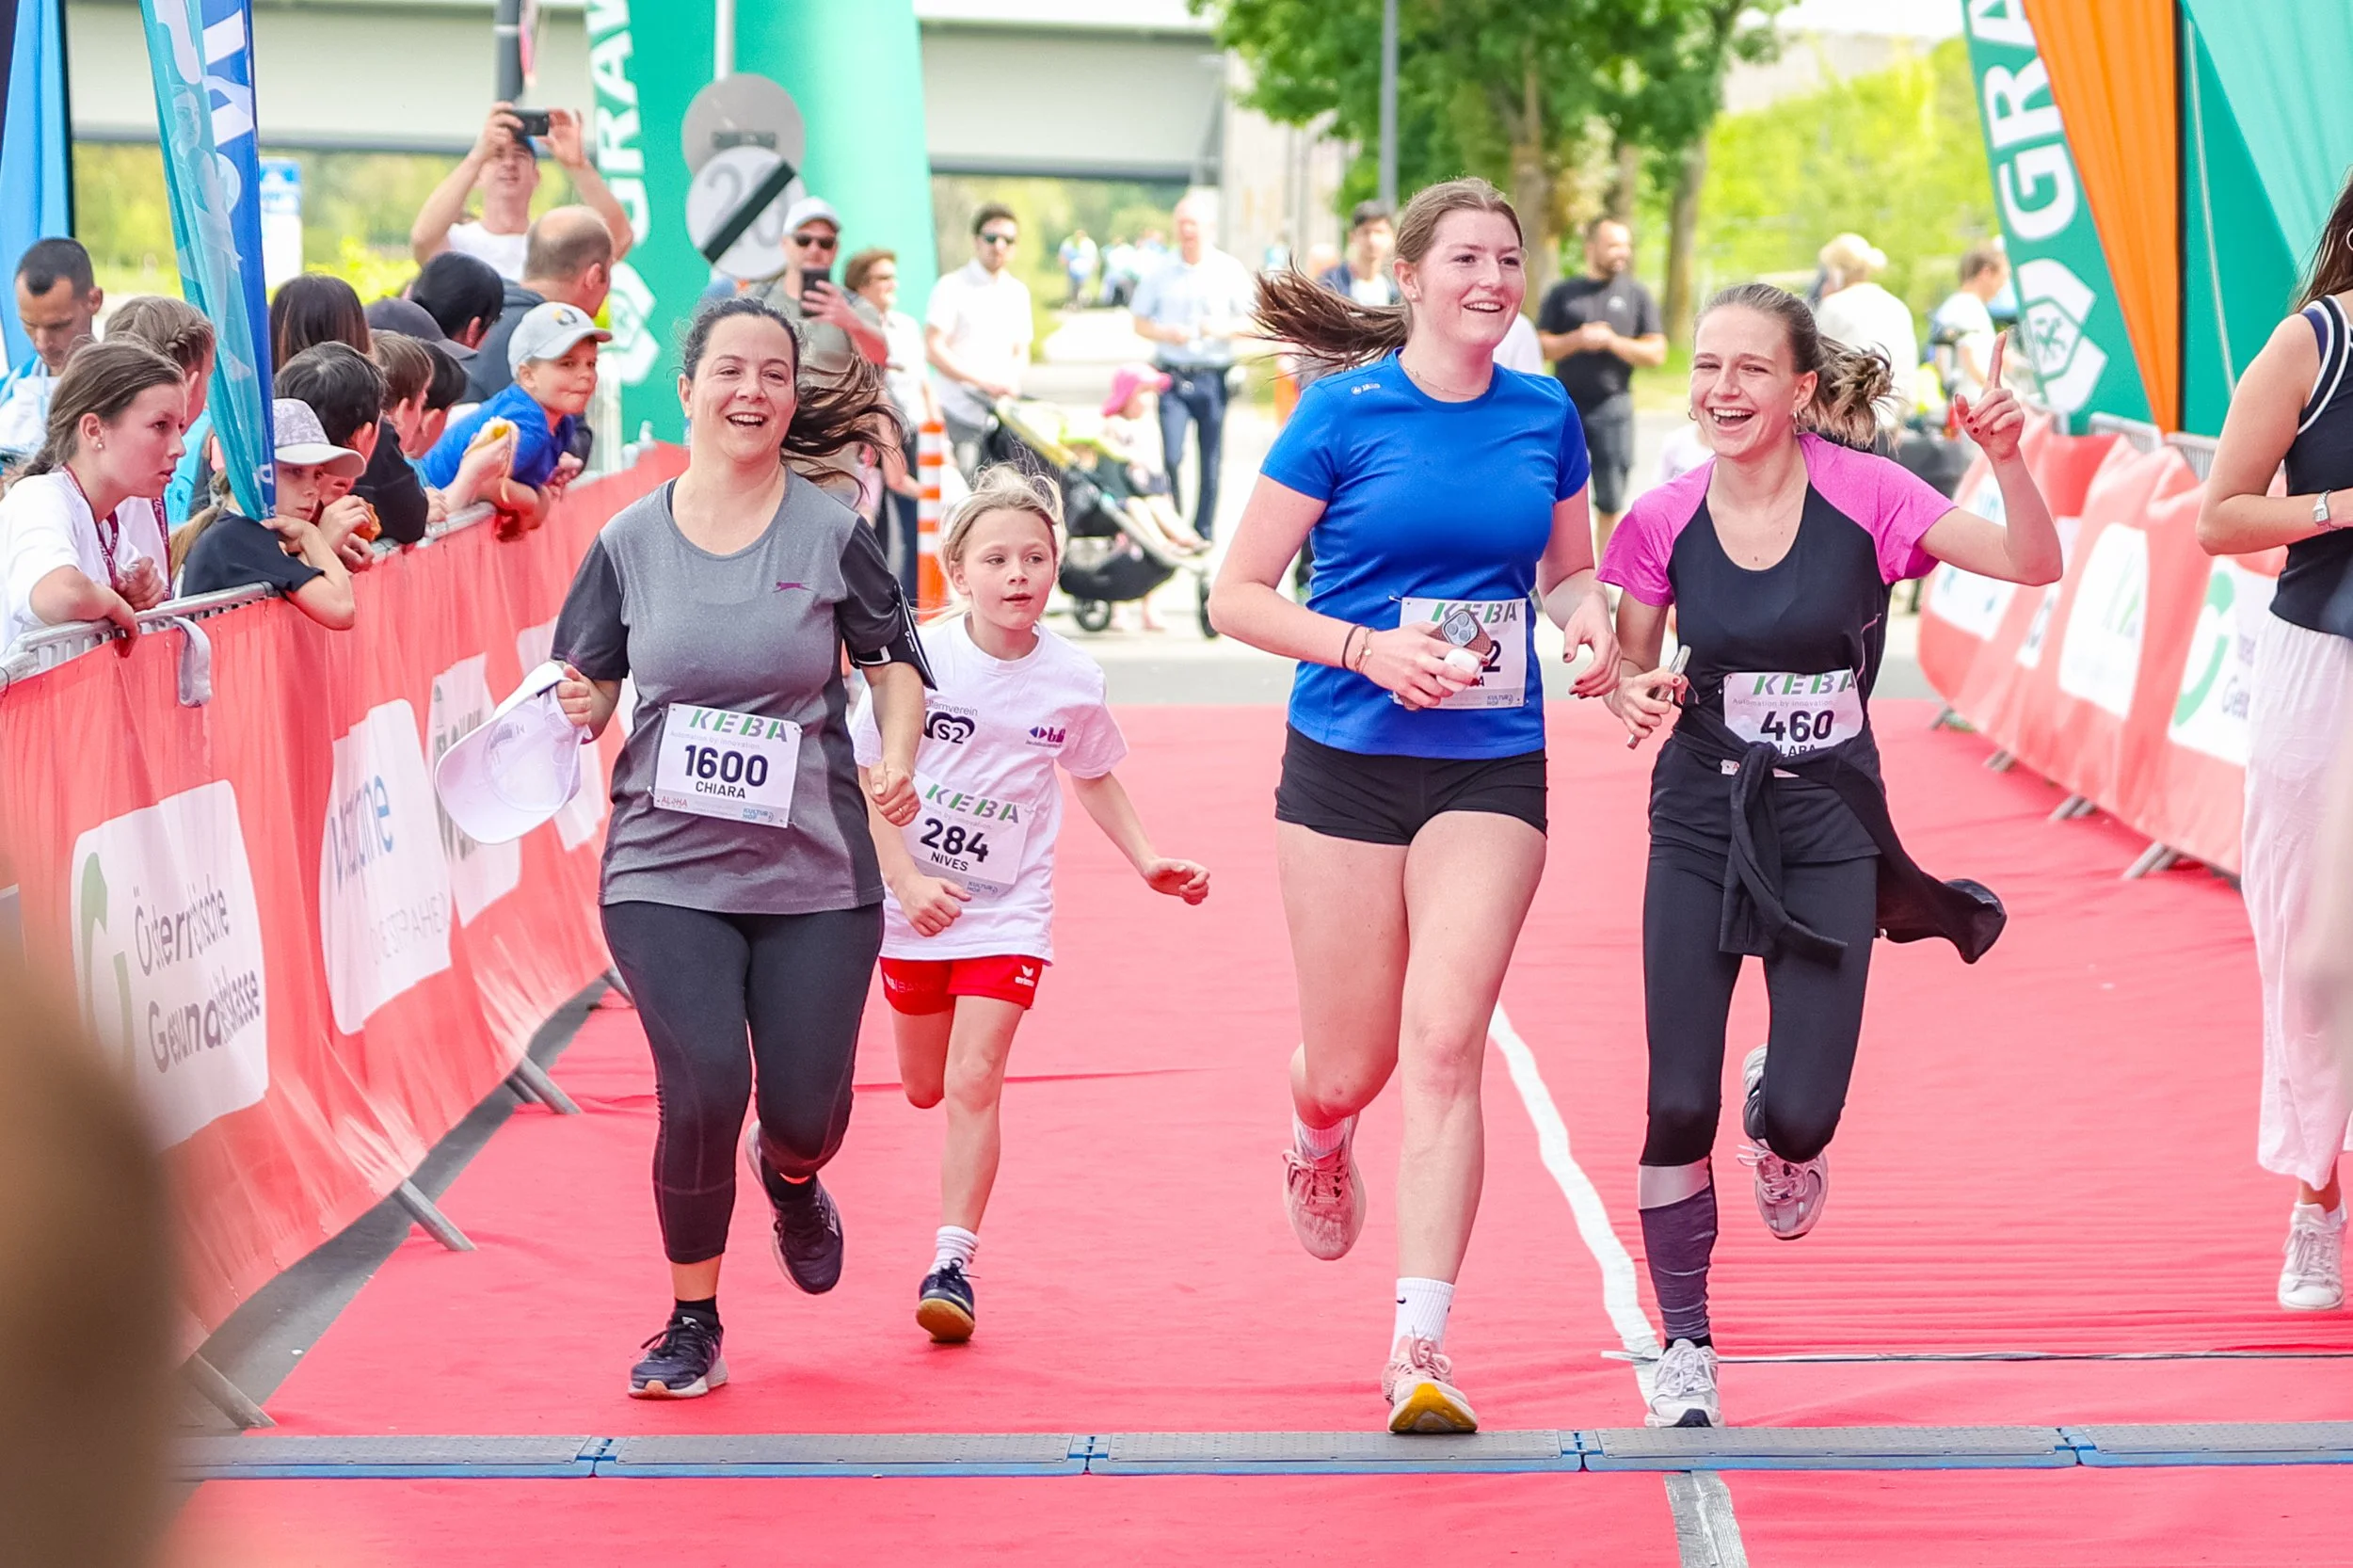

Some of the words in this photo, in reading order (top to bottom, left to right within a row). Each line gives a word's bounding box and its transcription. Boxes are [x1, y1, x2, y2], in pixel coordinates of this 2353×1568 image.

[1753, 672, 1856, 696] KEBA
[689, 709, 788, 743] KEBA
[1760, 710, 1835, 743] 460
[684, 744, 769, 788] 1600
[695, 780, 746, 800] CHIARA
[925, 783, 1019, 824] KEBA
[743, 807, 770, 818] KULTUR
[920, 817, 989, 863] 284
[930, 851, 969, 872] NIVES
